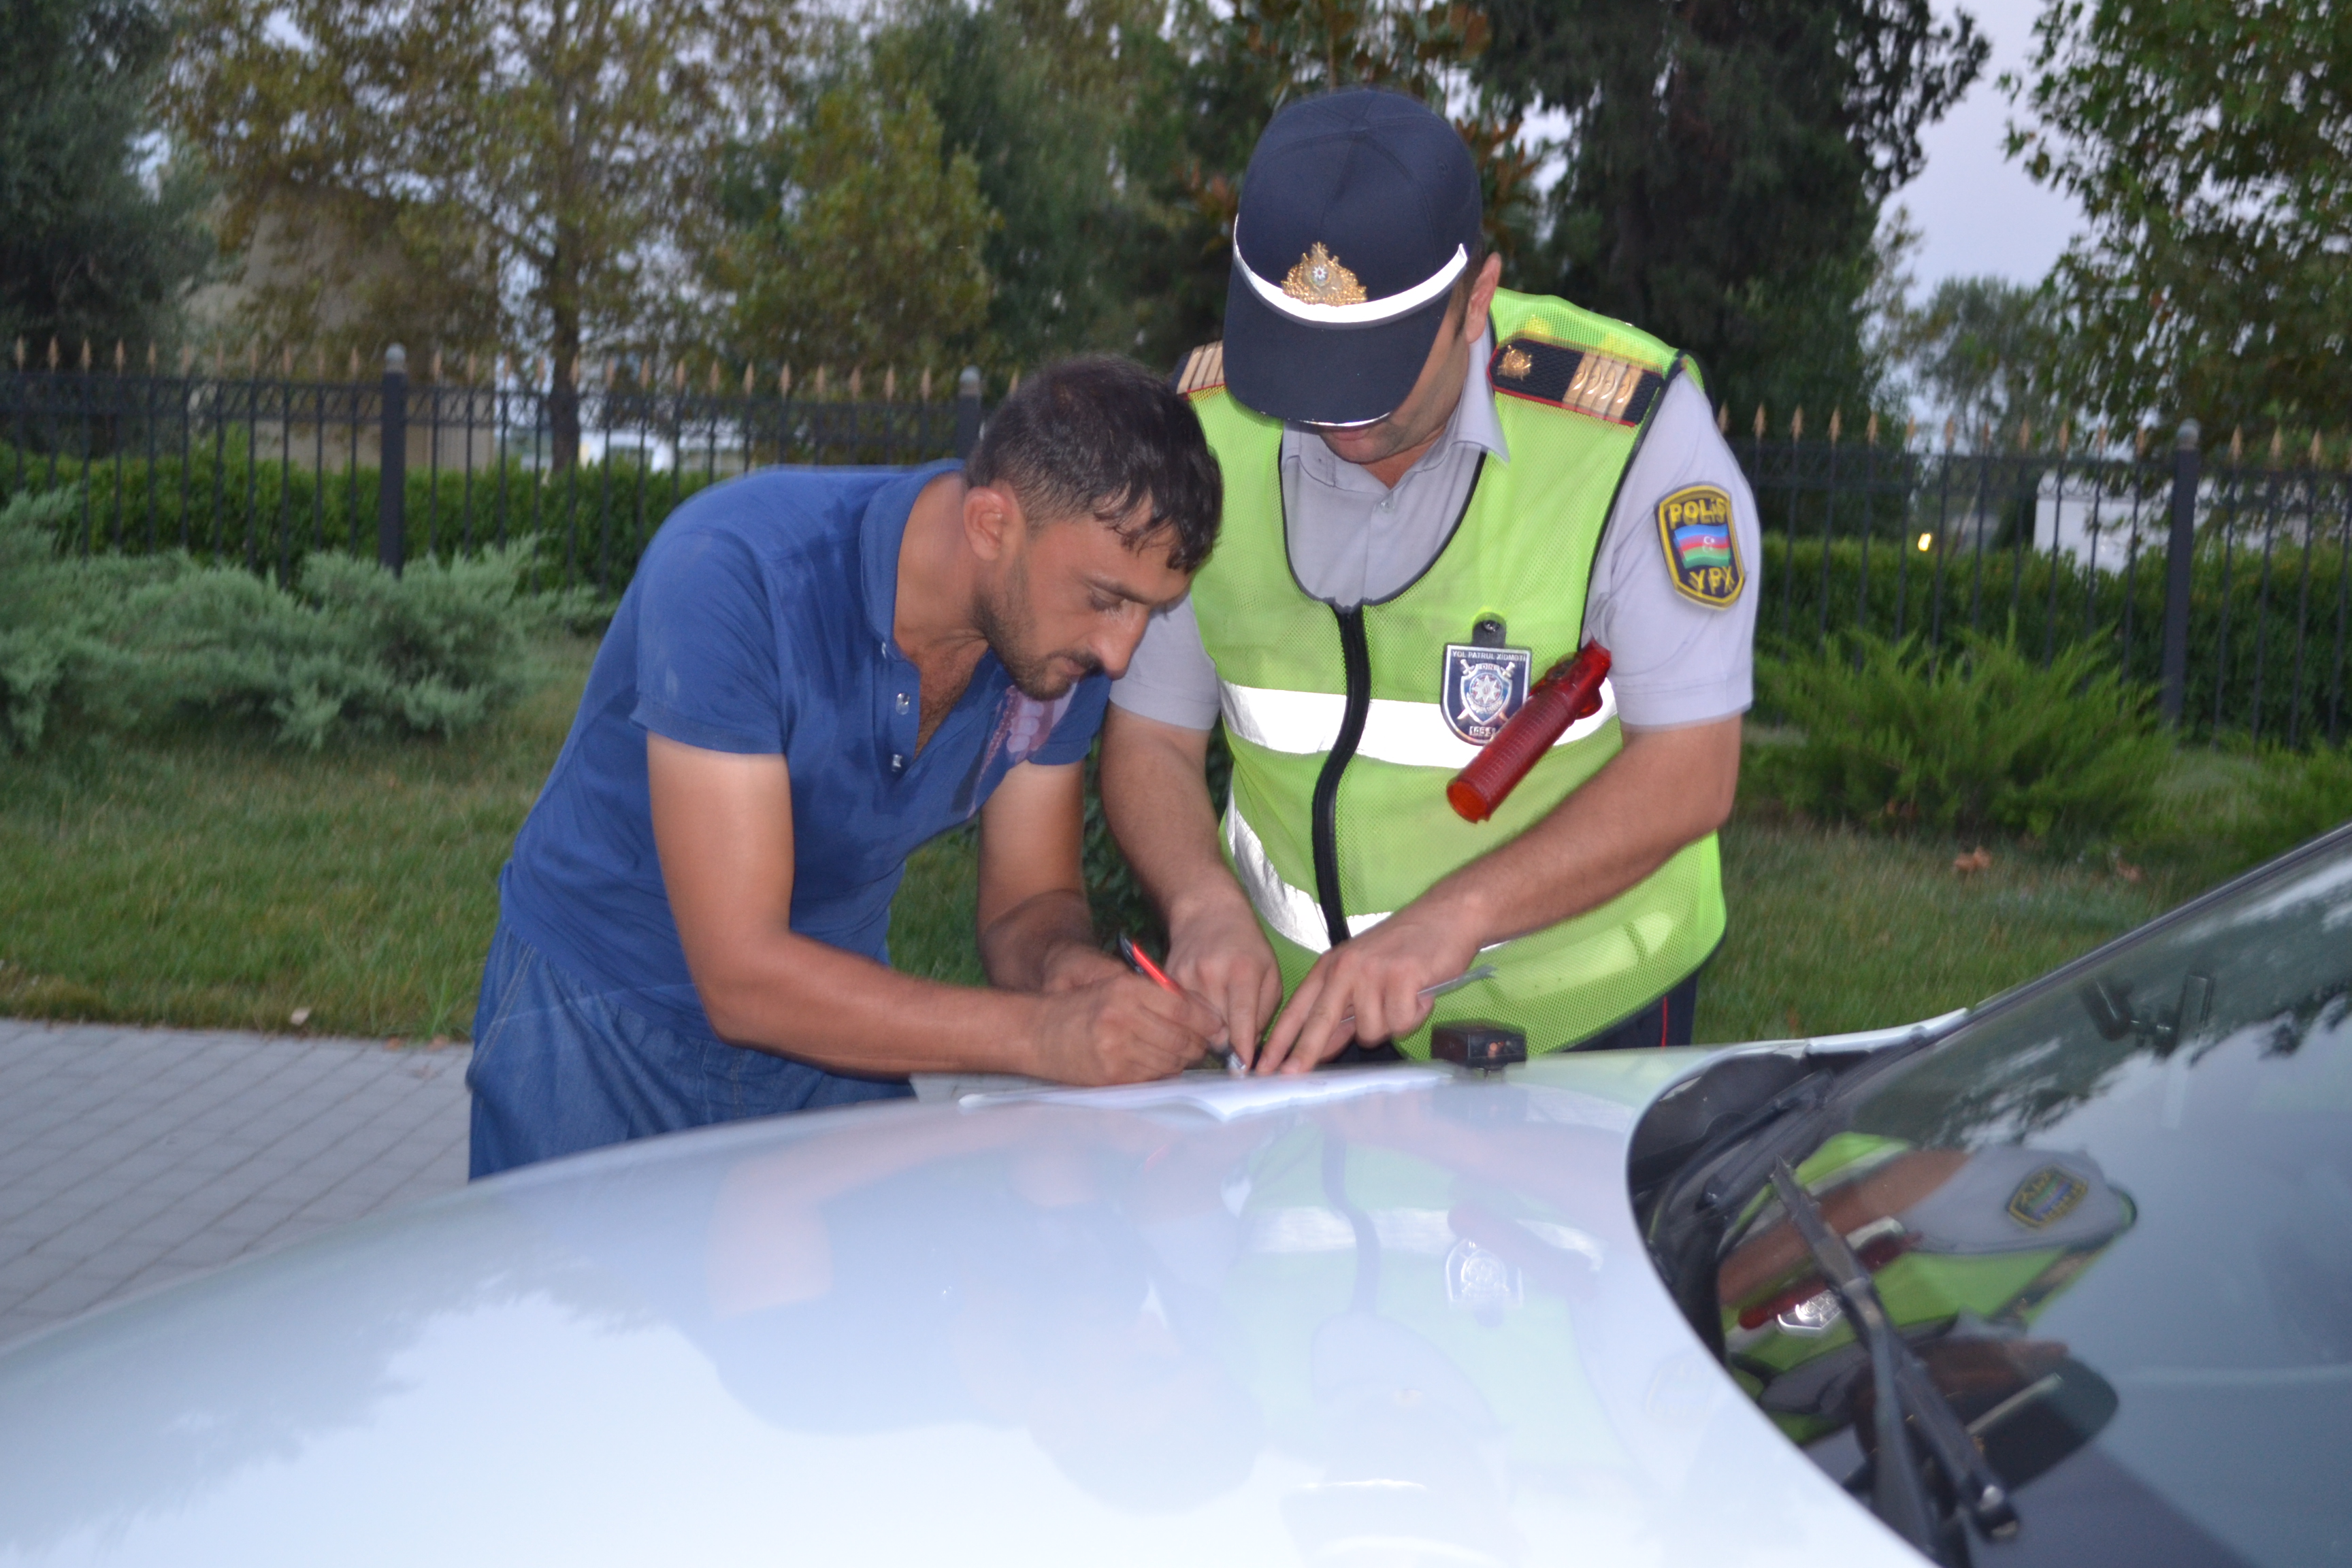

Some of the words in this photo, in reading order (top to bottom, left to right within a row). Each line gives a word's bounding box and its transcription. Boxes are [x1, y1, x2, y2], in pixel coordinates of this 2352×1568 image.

[1689, 566, 1735, 590] YPX
[1452, 650, 1467, 658] YOL
[1468, 651, 1494, 660] PATRUL
